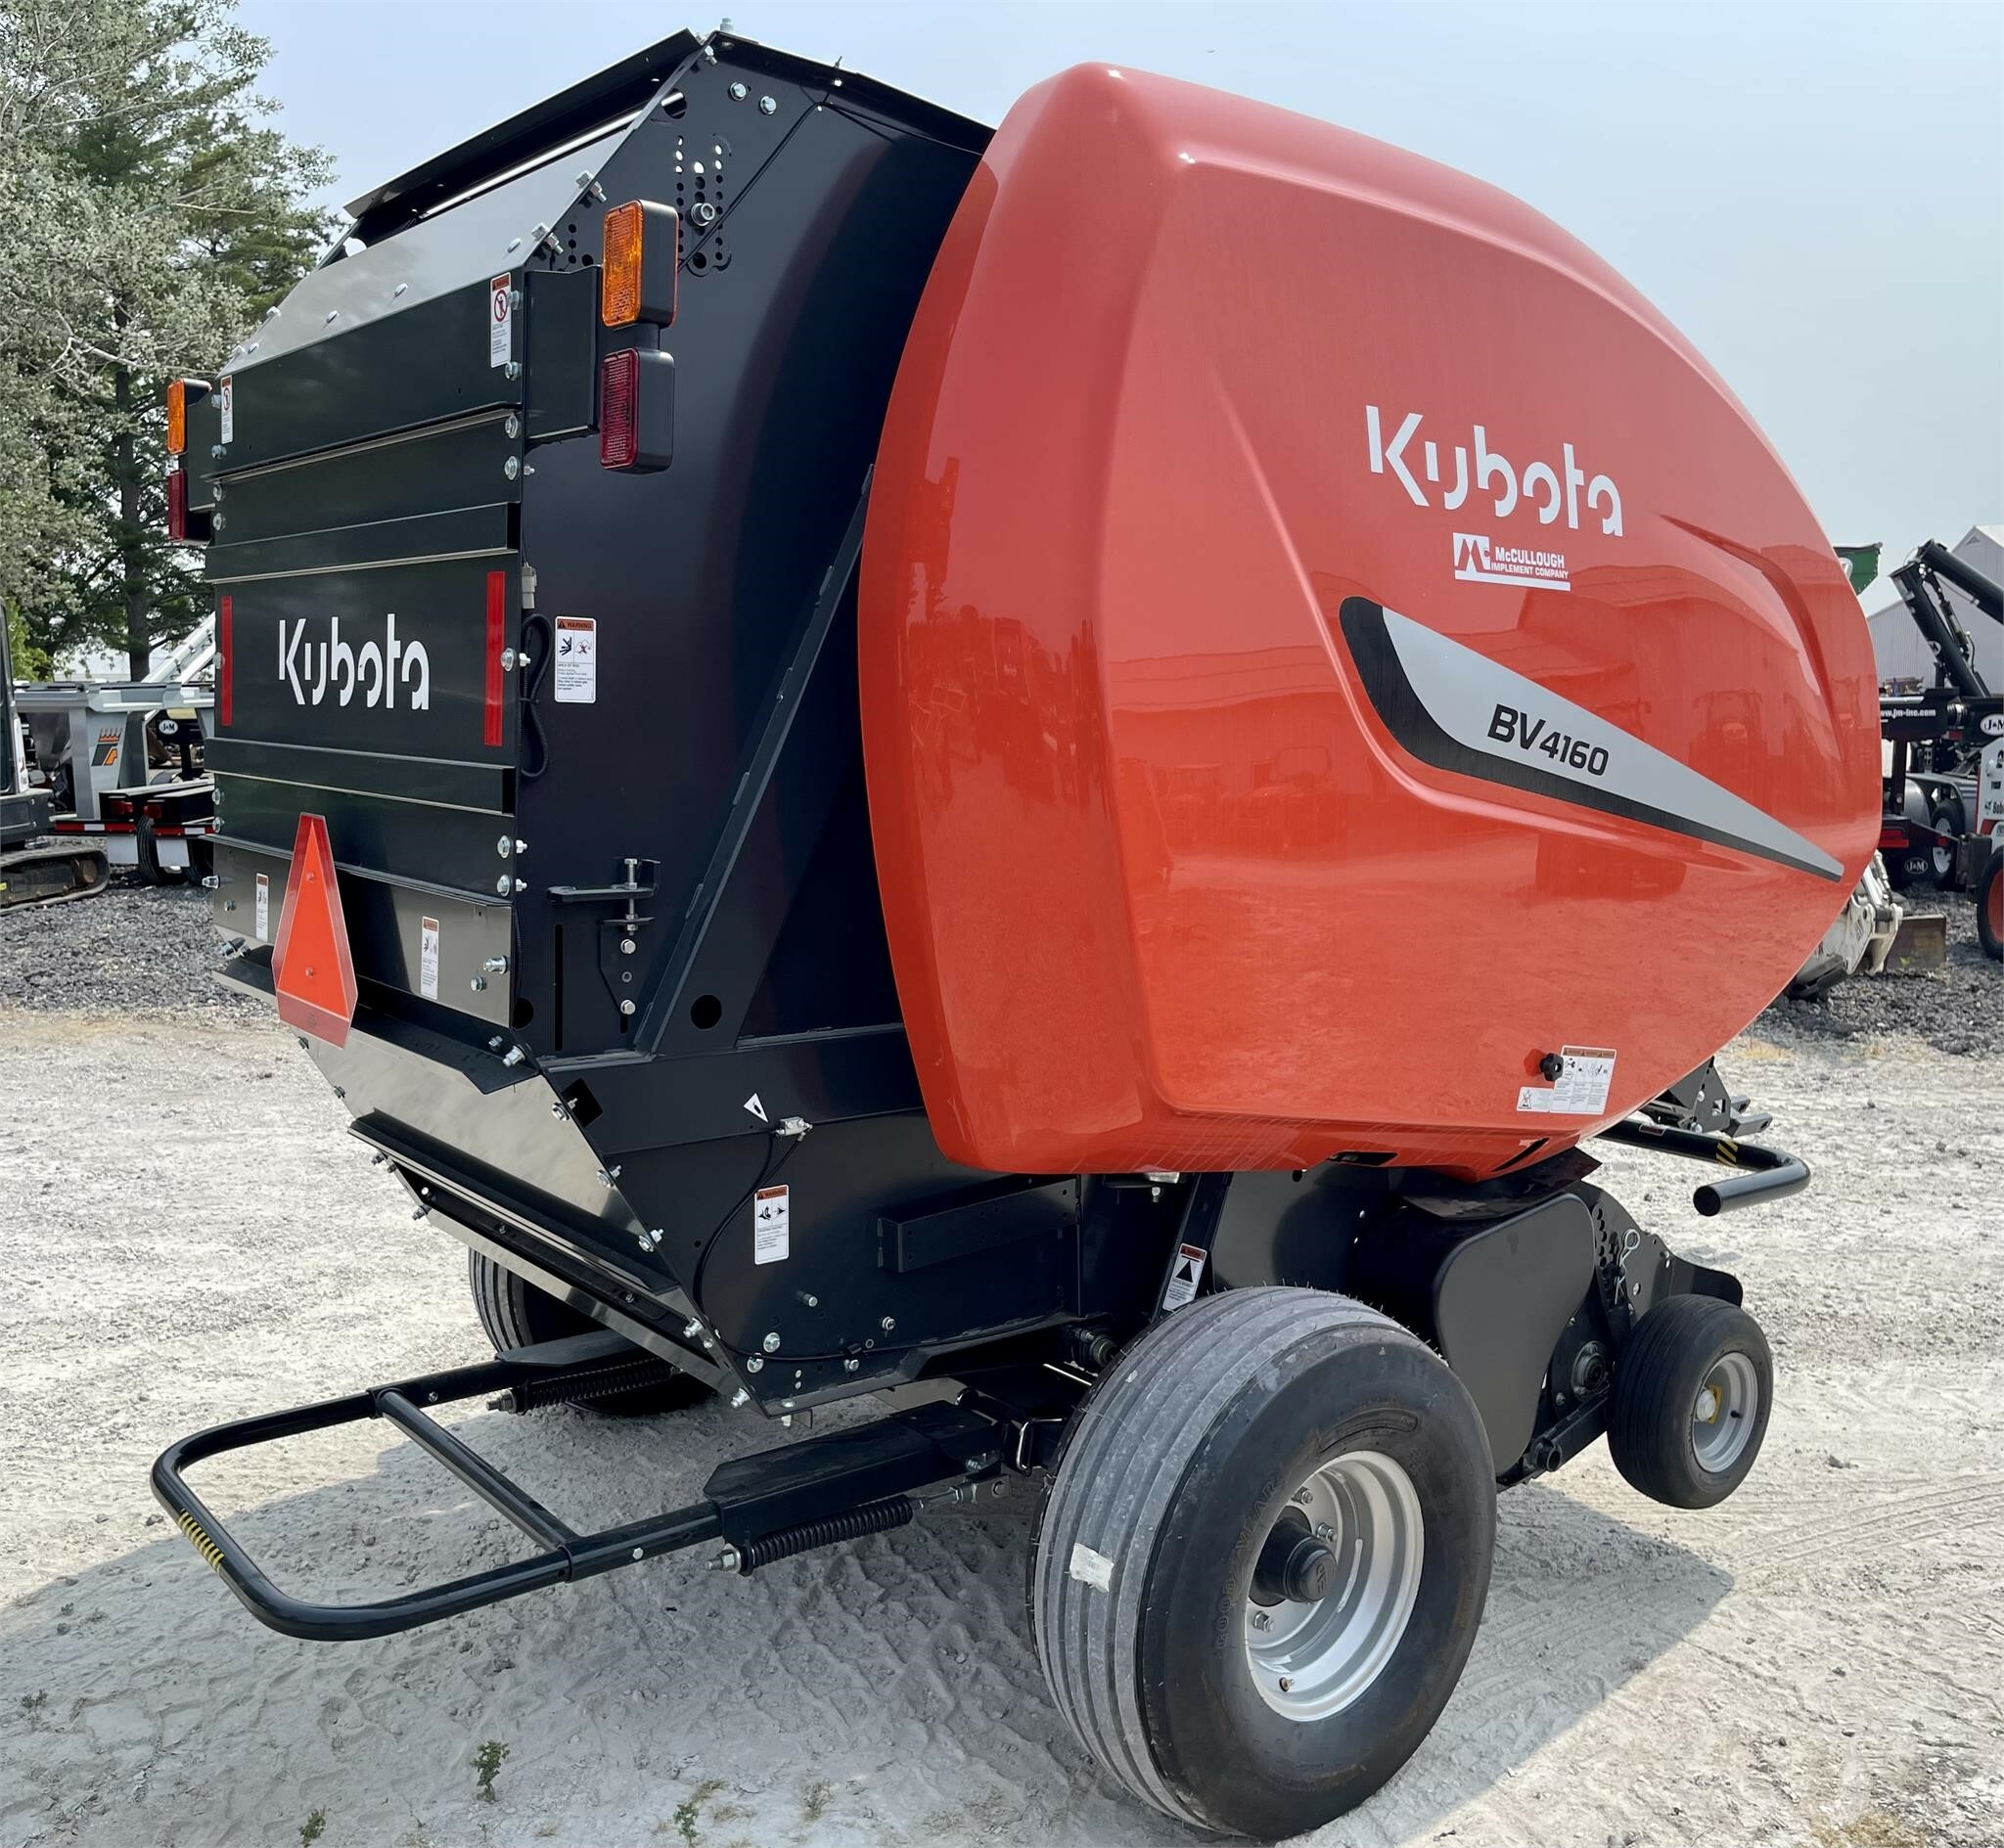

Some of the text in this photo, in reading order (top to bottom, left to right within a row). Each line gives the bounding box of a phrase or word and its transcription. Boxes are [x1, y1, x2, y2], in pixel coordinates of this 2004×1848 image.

[1366, 404, 1623, 537] Kubota
[1491, 562, 1569, 579] IMPLEMENT COMPANY
[1495, 546, 1565, 568] McCULLOUGH
[278, 612, 430, 710] Kubota
[1487, 703, 1610, 776] BV4160
